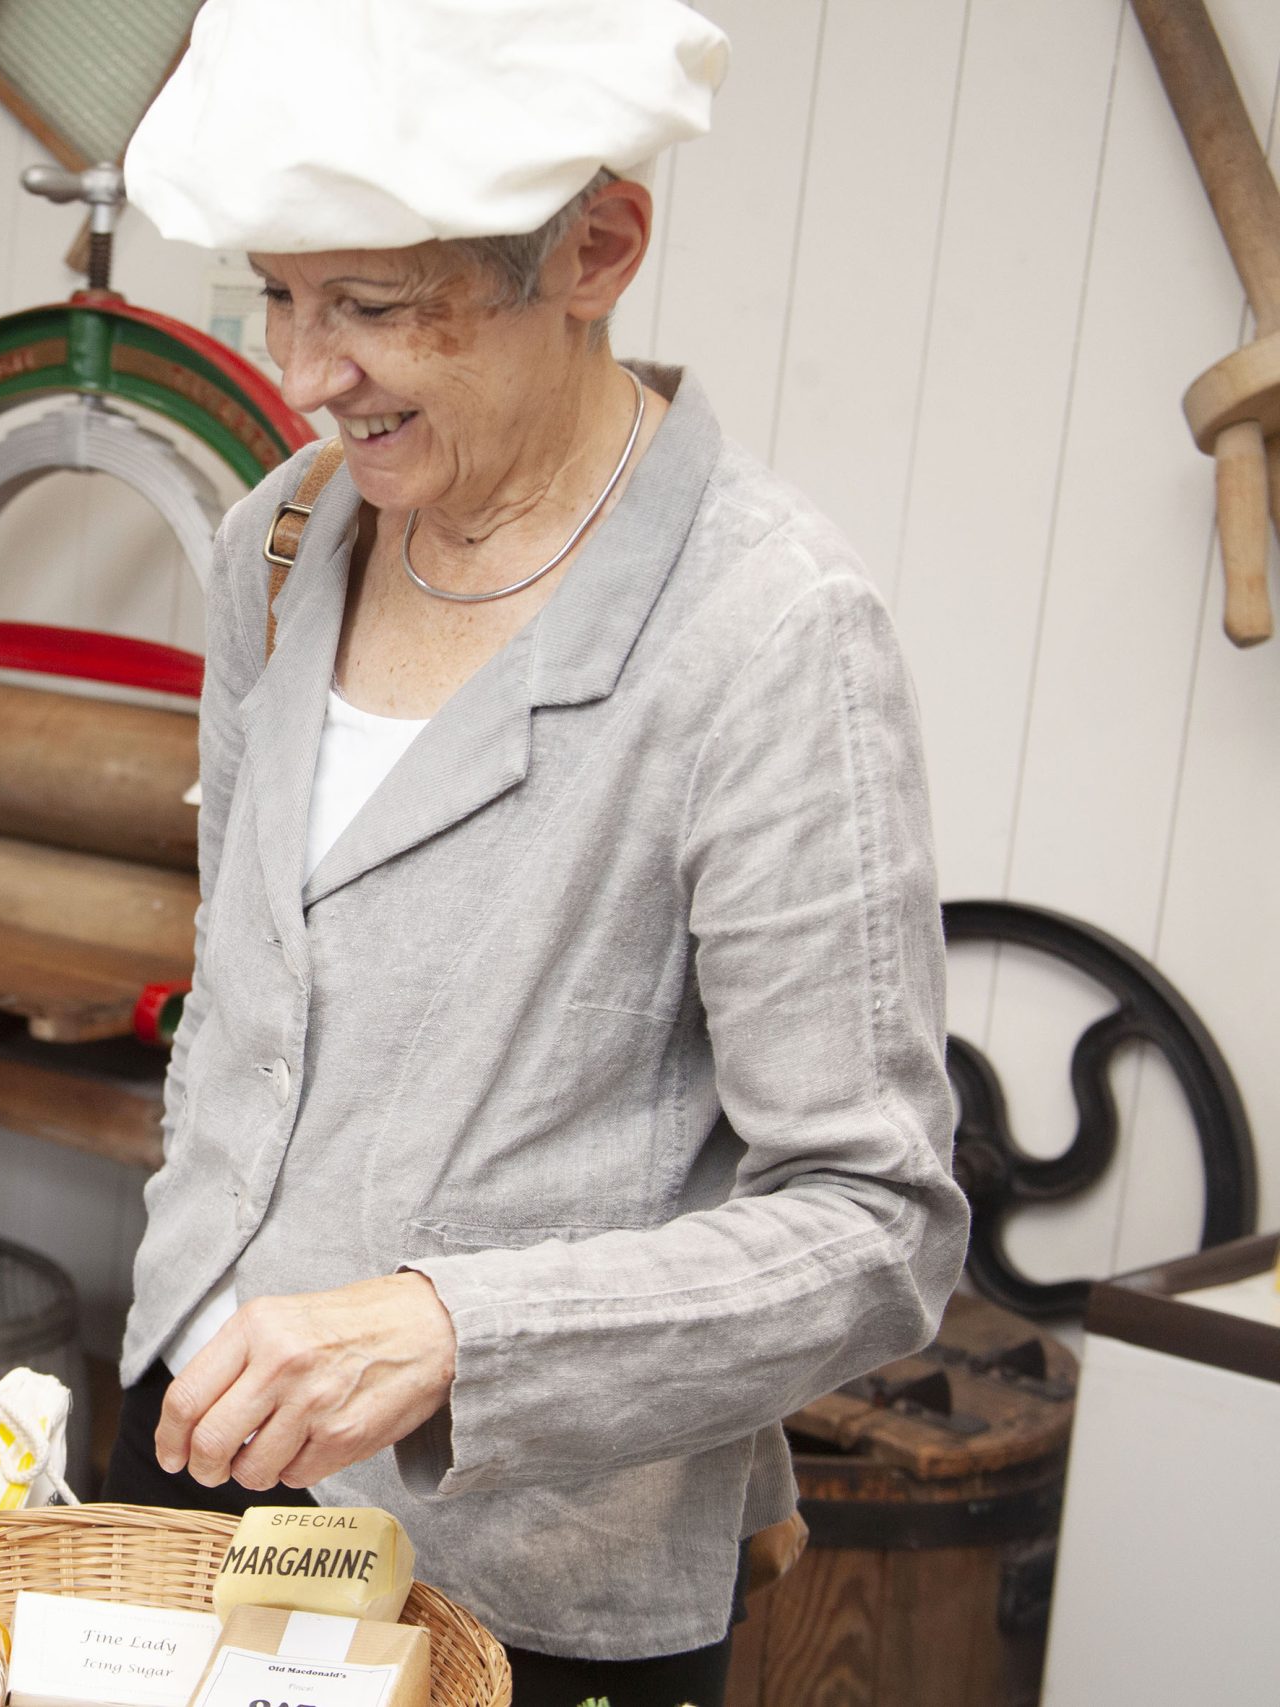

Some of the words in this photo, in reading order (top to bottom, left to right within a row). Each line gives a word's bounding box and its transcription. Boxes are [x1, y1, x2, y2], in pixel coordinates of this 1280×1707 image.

[271, 1513, 358, 1529] SPECIAL
[221, 1545, 378, 1583] MARGARINE
[80, 1629, 123, 1646] Fine
[129, 1635, 177, 1656] Lady
[82, 1658, 122, 1674] Icing
[127, 1663, 174, 1679] Sugar
[268, 1665, 285, 1673] Old
[287, 1667, 347, 1679] Macdonald's
